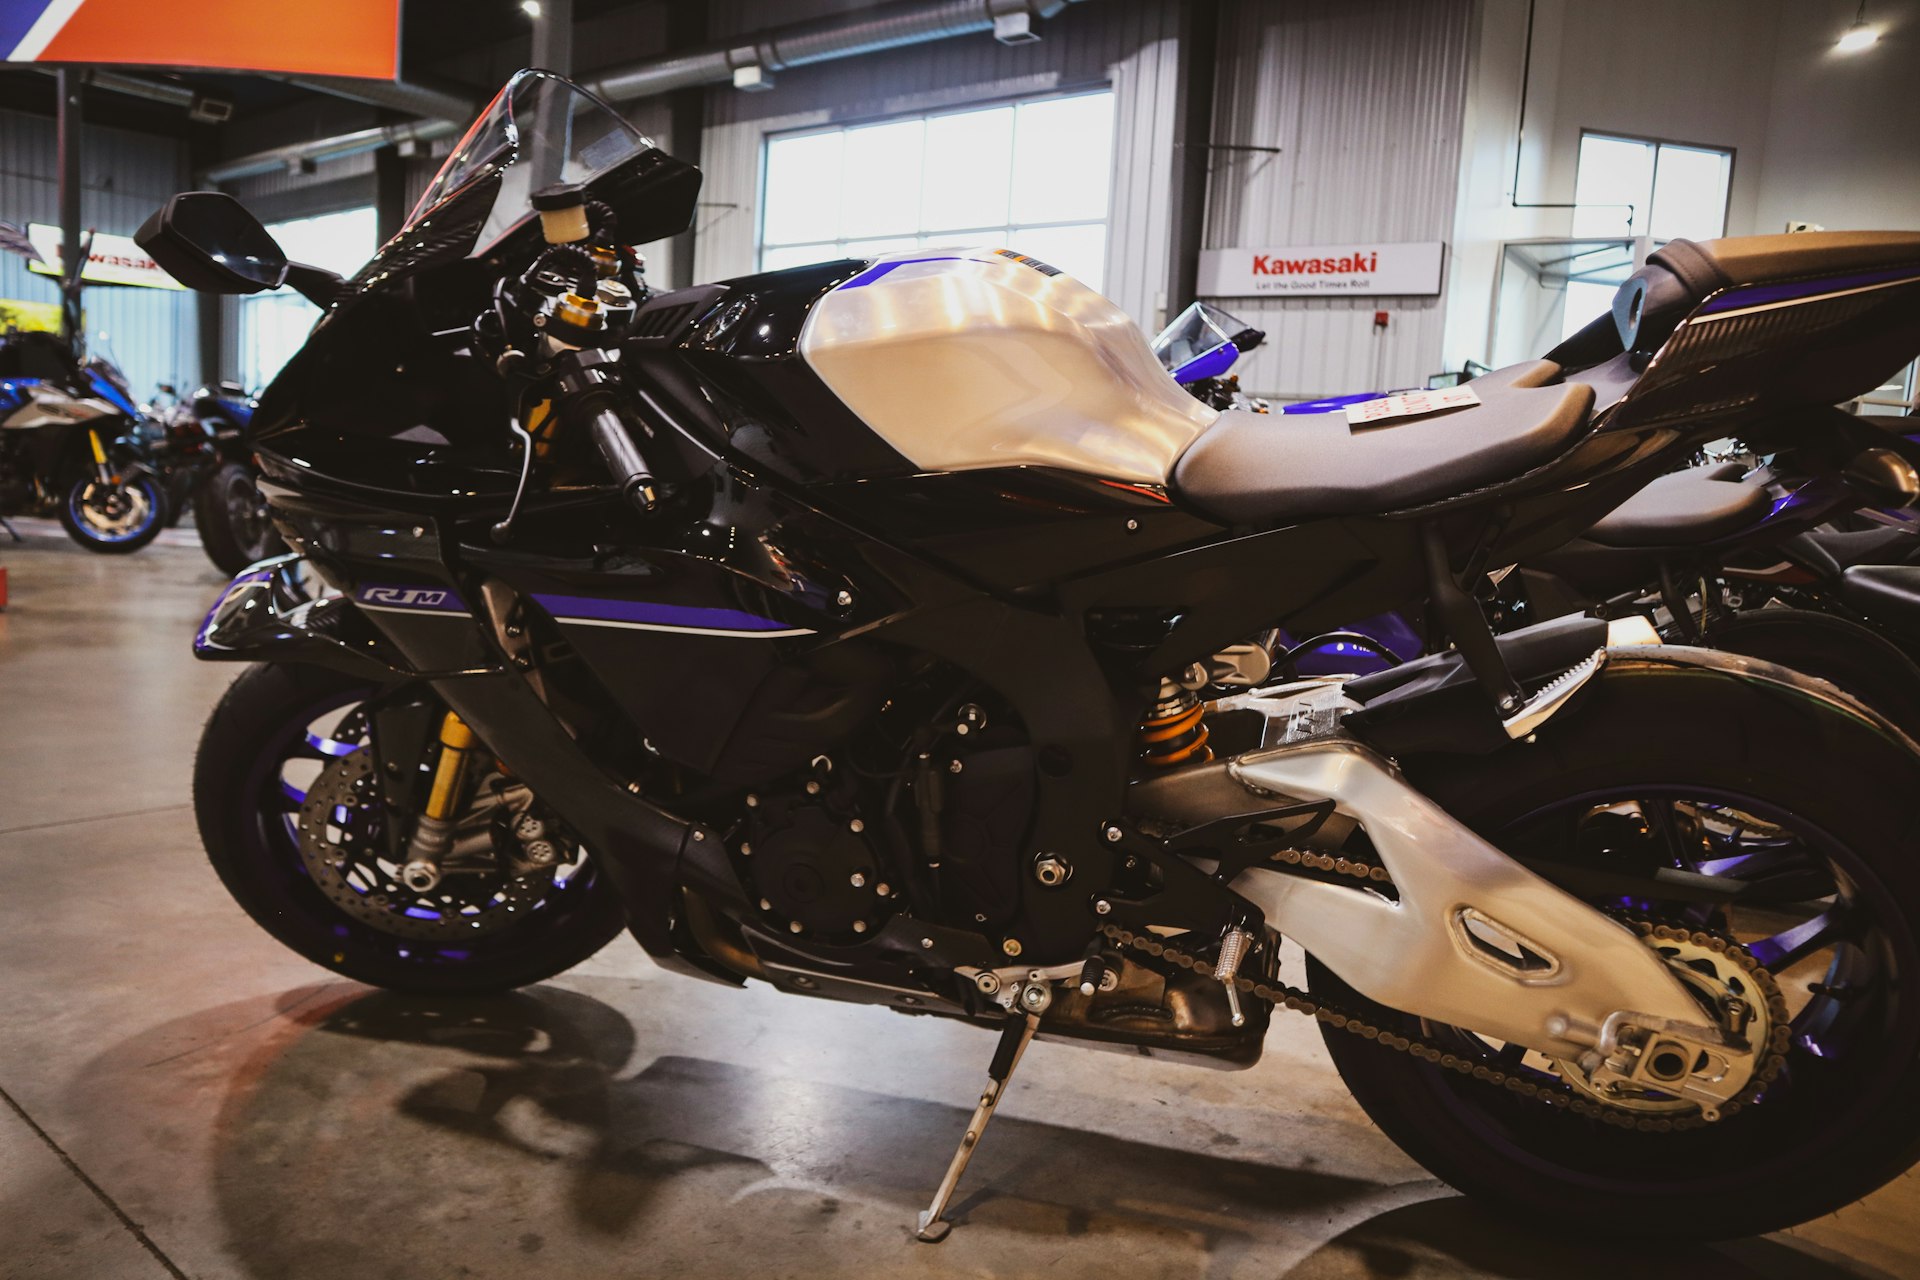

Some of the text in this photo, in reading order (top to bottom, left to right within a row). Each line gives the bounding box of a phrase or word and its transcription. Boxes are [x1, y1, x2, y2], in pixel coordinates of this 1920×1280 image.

[1253, 252, 1377, 275] Kawasaki
[1257, 279, 1370, 290] Let the Good Times Roll
[364, 587, 447, 605] R1M
